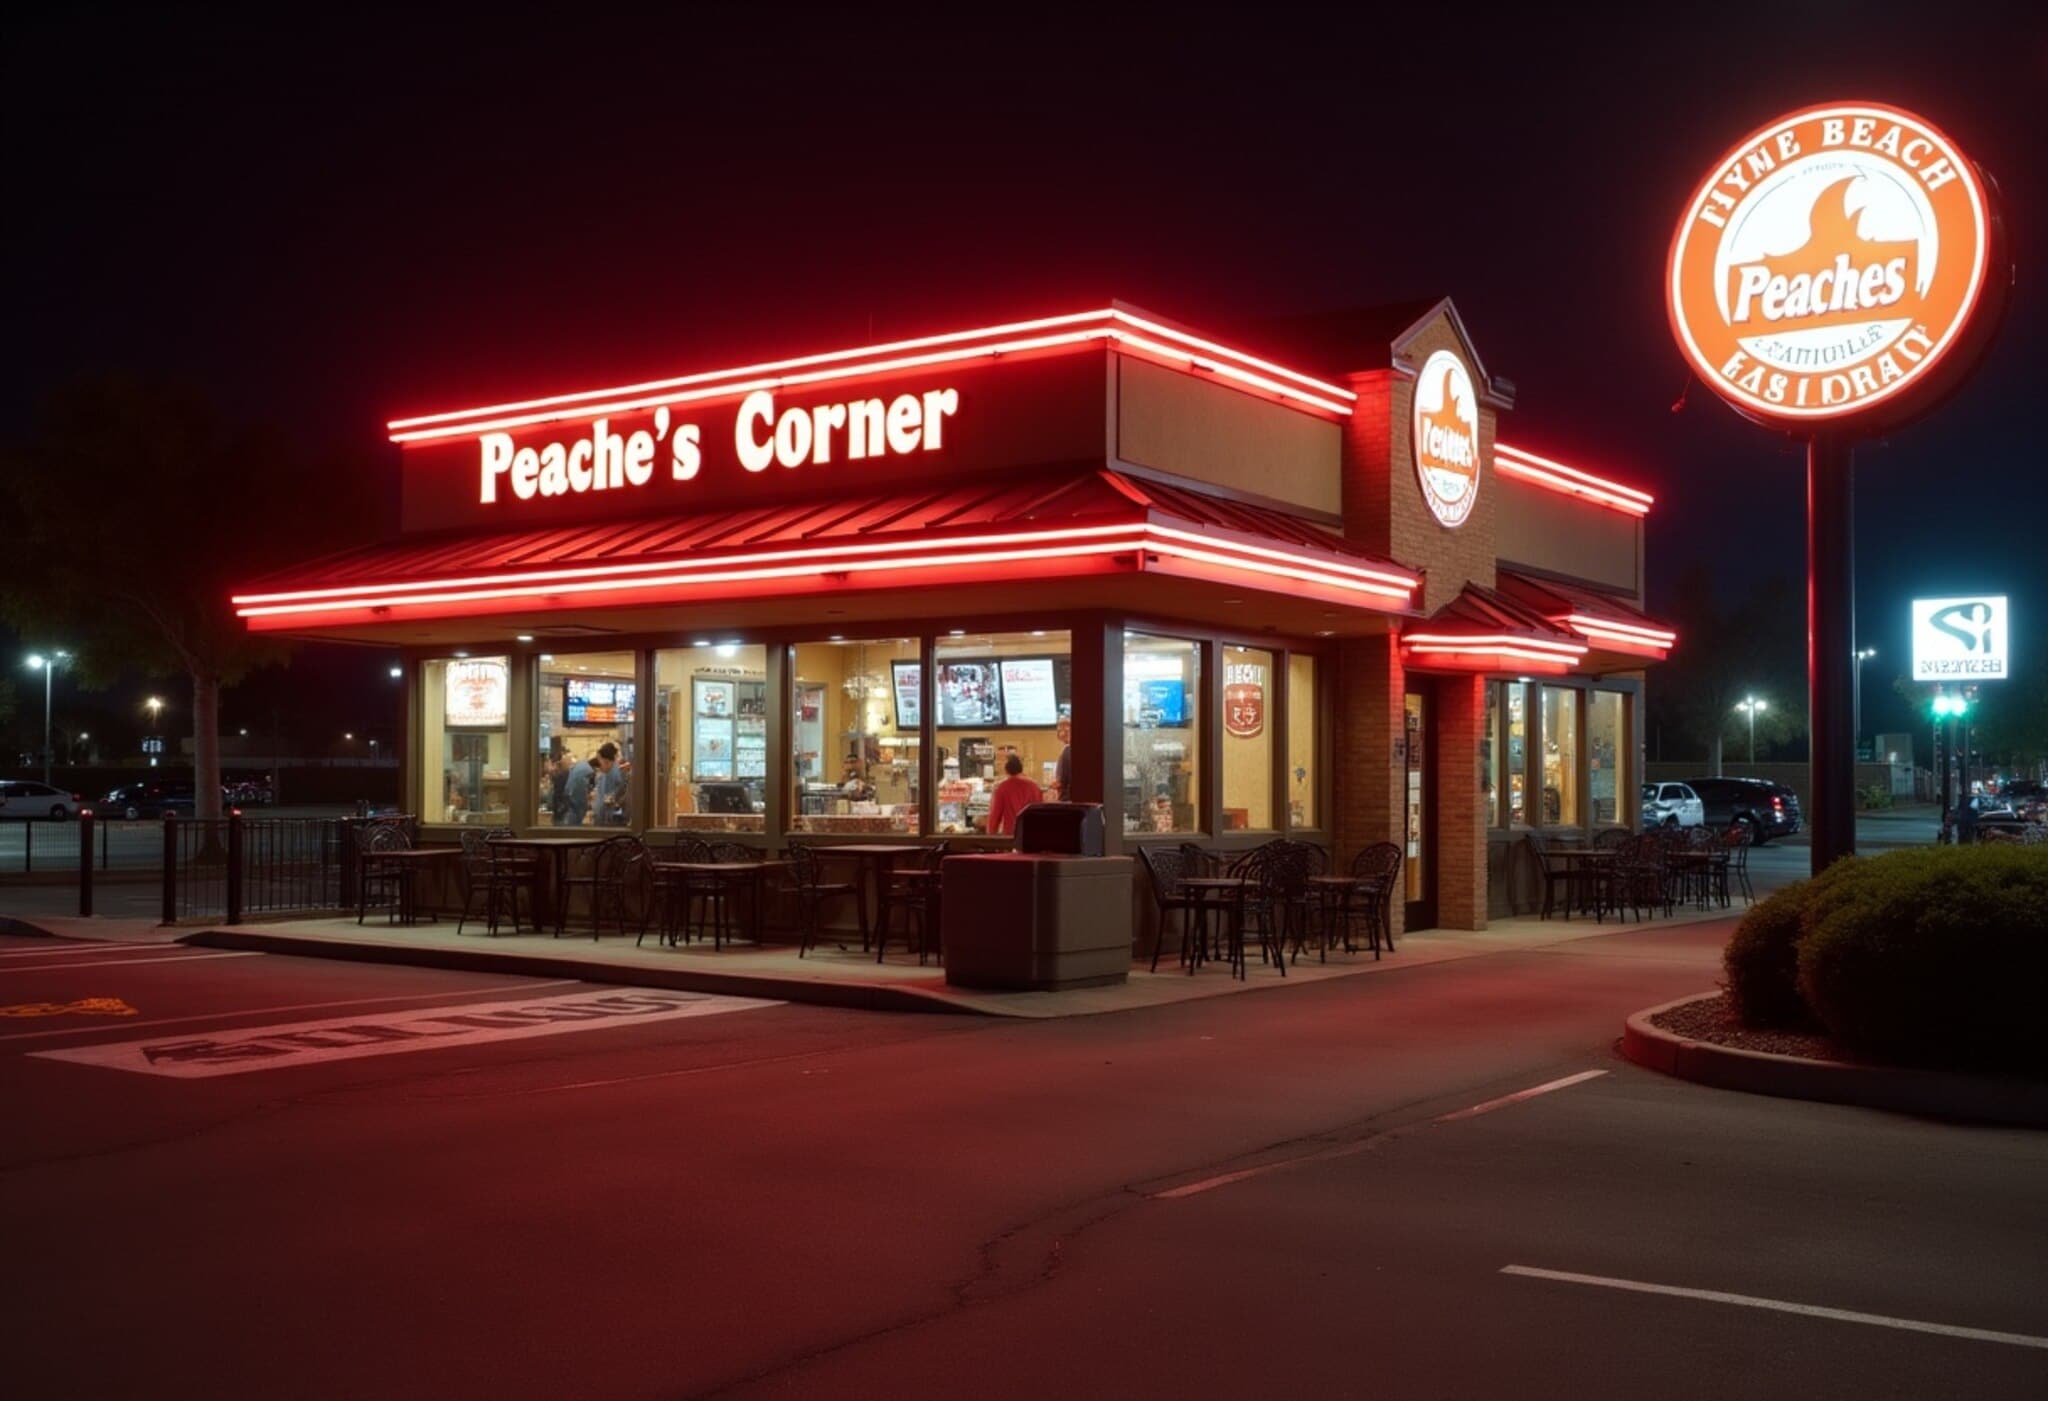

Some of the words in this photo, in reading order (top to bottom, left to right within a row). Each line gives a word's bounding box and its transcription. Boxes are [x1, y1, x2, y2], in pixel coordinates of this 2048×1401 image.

[1821, 118, 1958, 191] BEACH
[1732, 253, 1907, 322] Peaches
[479, 404, 701, 504] Peache's
[734, 387, 960, 473] Corner
